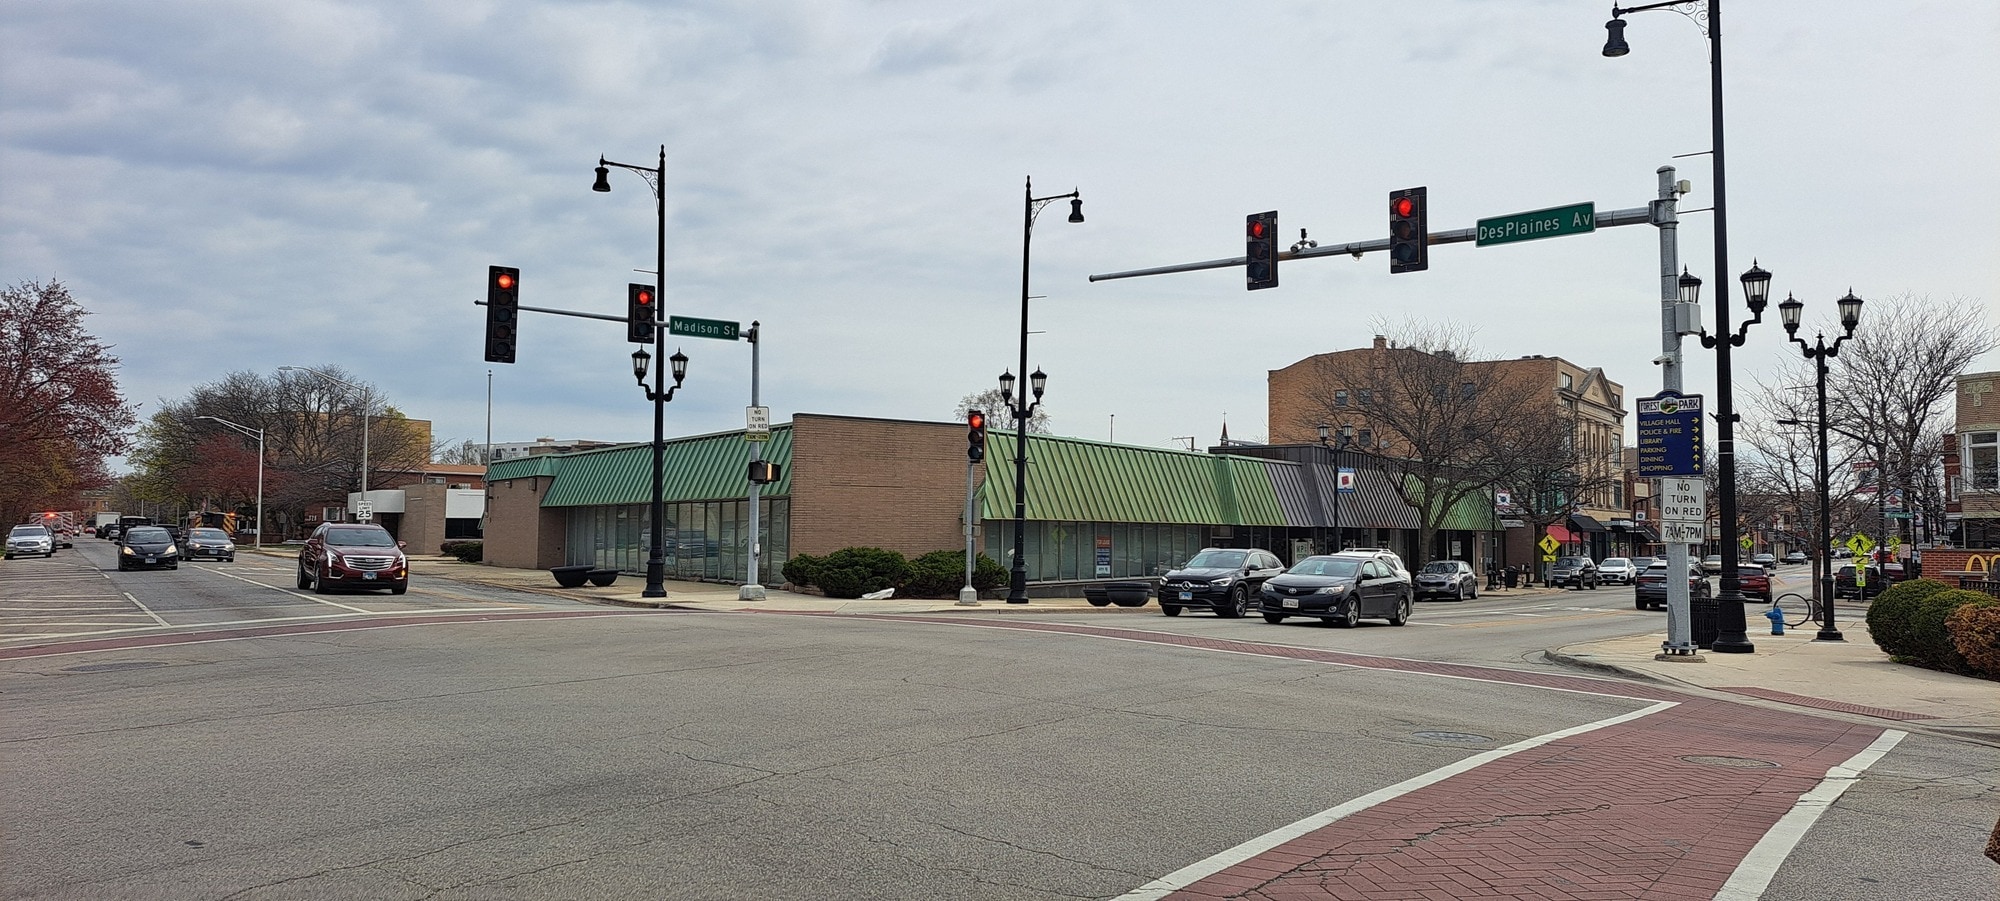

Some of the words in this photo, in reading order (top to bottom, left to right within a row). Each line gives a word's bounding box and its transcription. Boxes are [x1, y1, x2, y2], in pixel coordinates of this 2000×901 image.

[1479, 218, 1560, 240] DesPlaines
[1572, 212, 1591, 228] Av
[674, 320, 719, 335] Madison
[723, 325, 735, 336] St
[1640, 401, 1660, 412] FOREST
[1678, 398, 1699, 410] PARK
[1676, 483, 1690, 491] NO
[1670, 494, 1697, 504] TURN
[358, 510, 372, 518] 25
[1664, 506, 1679, 515] ON
[1682, 507, 1702, 516] RED
[1664, 526, 1702, 539] 7AM-7PM
